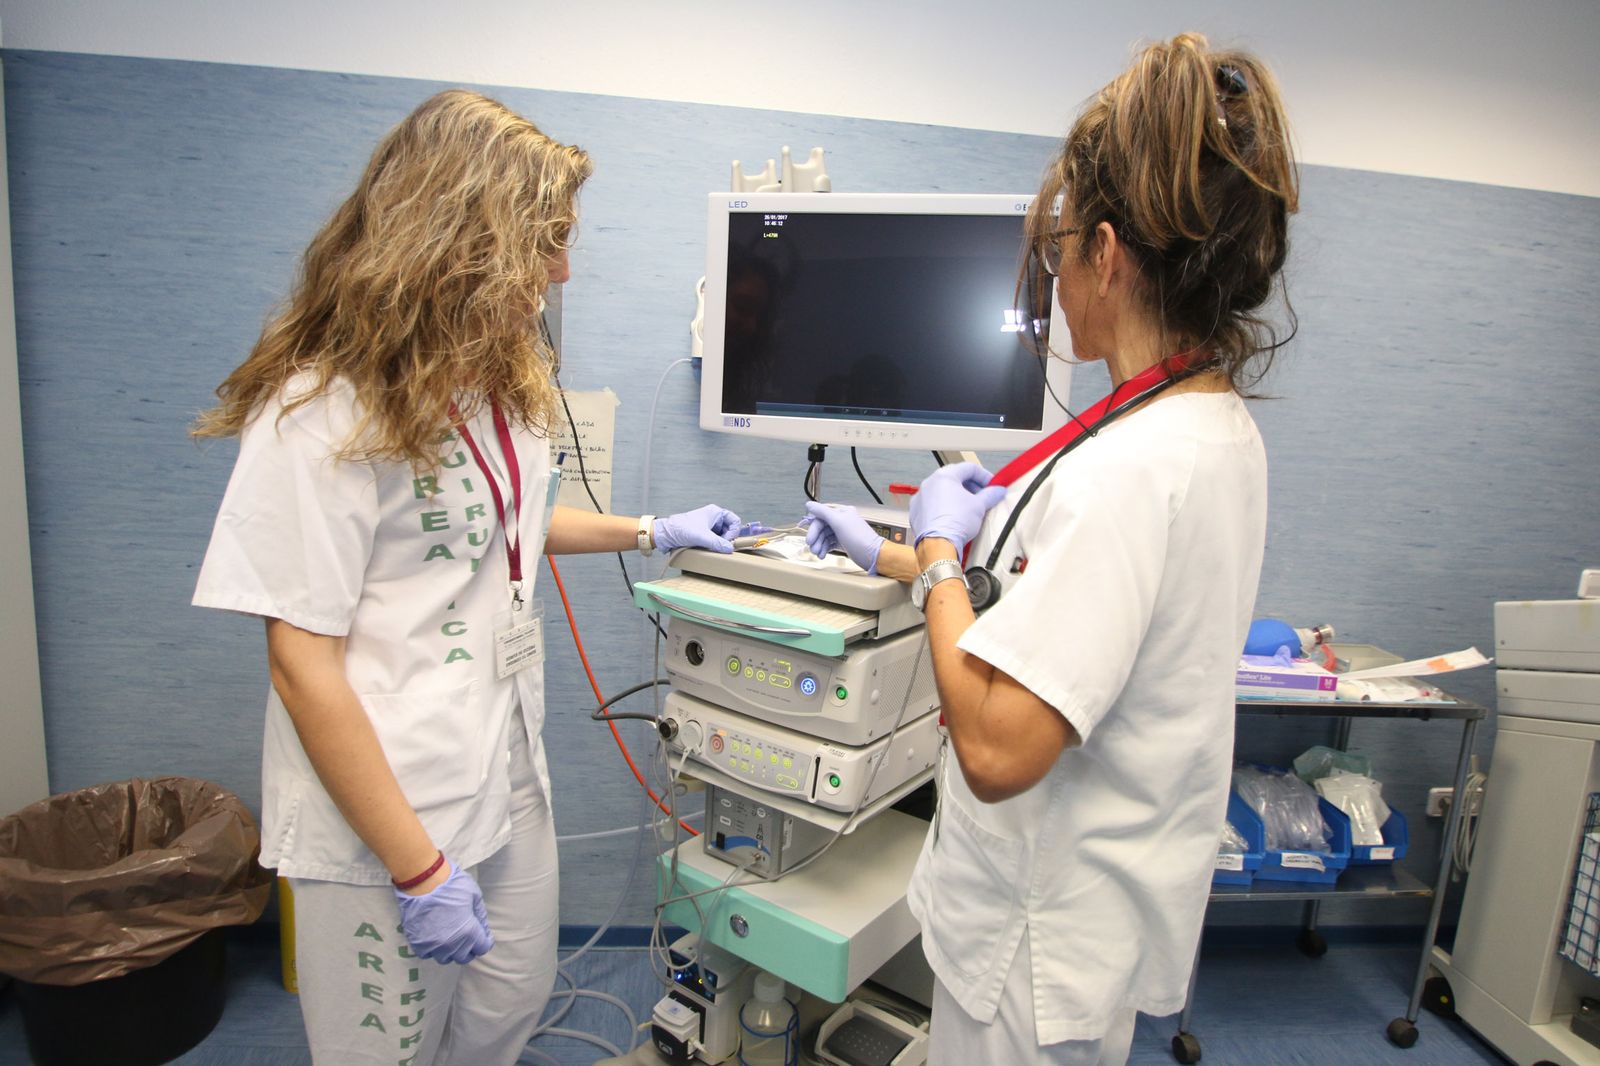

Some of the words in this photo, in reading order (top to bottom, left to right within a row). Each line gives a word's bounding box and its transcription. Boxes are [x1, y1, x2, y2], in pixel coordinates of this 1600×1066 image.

[728, 200, 748, 208] LED
[734, 417, 751, 428] NDS
[353, 921, 387, 1034] AREA
